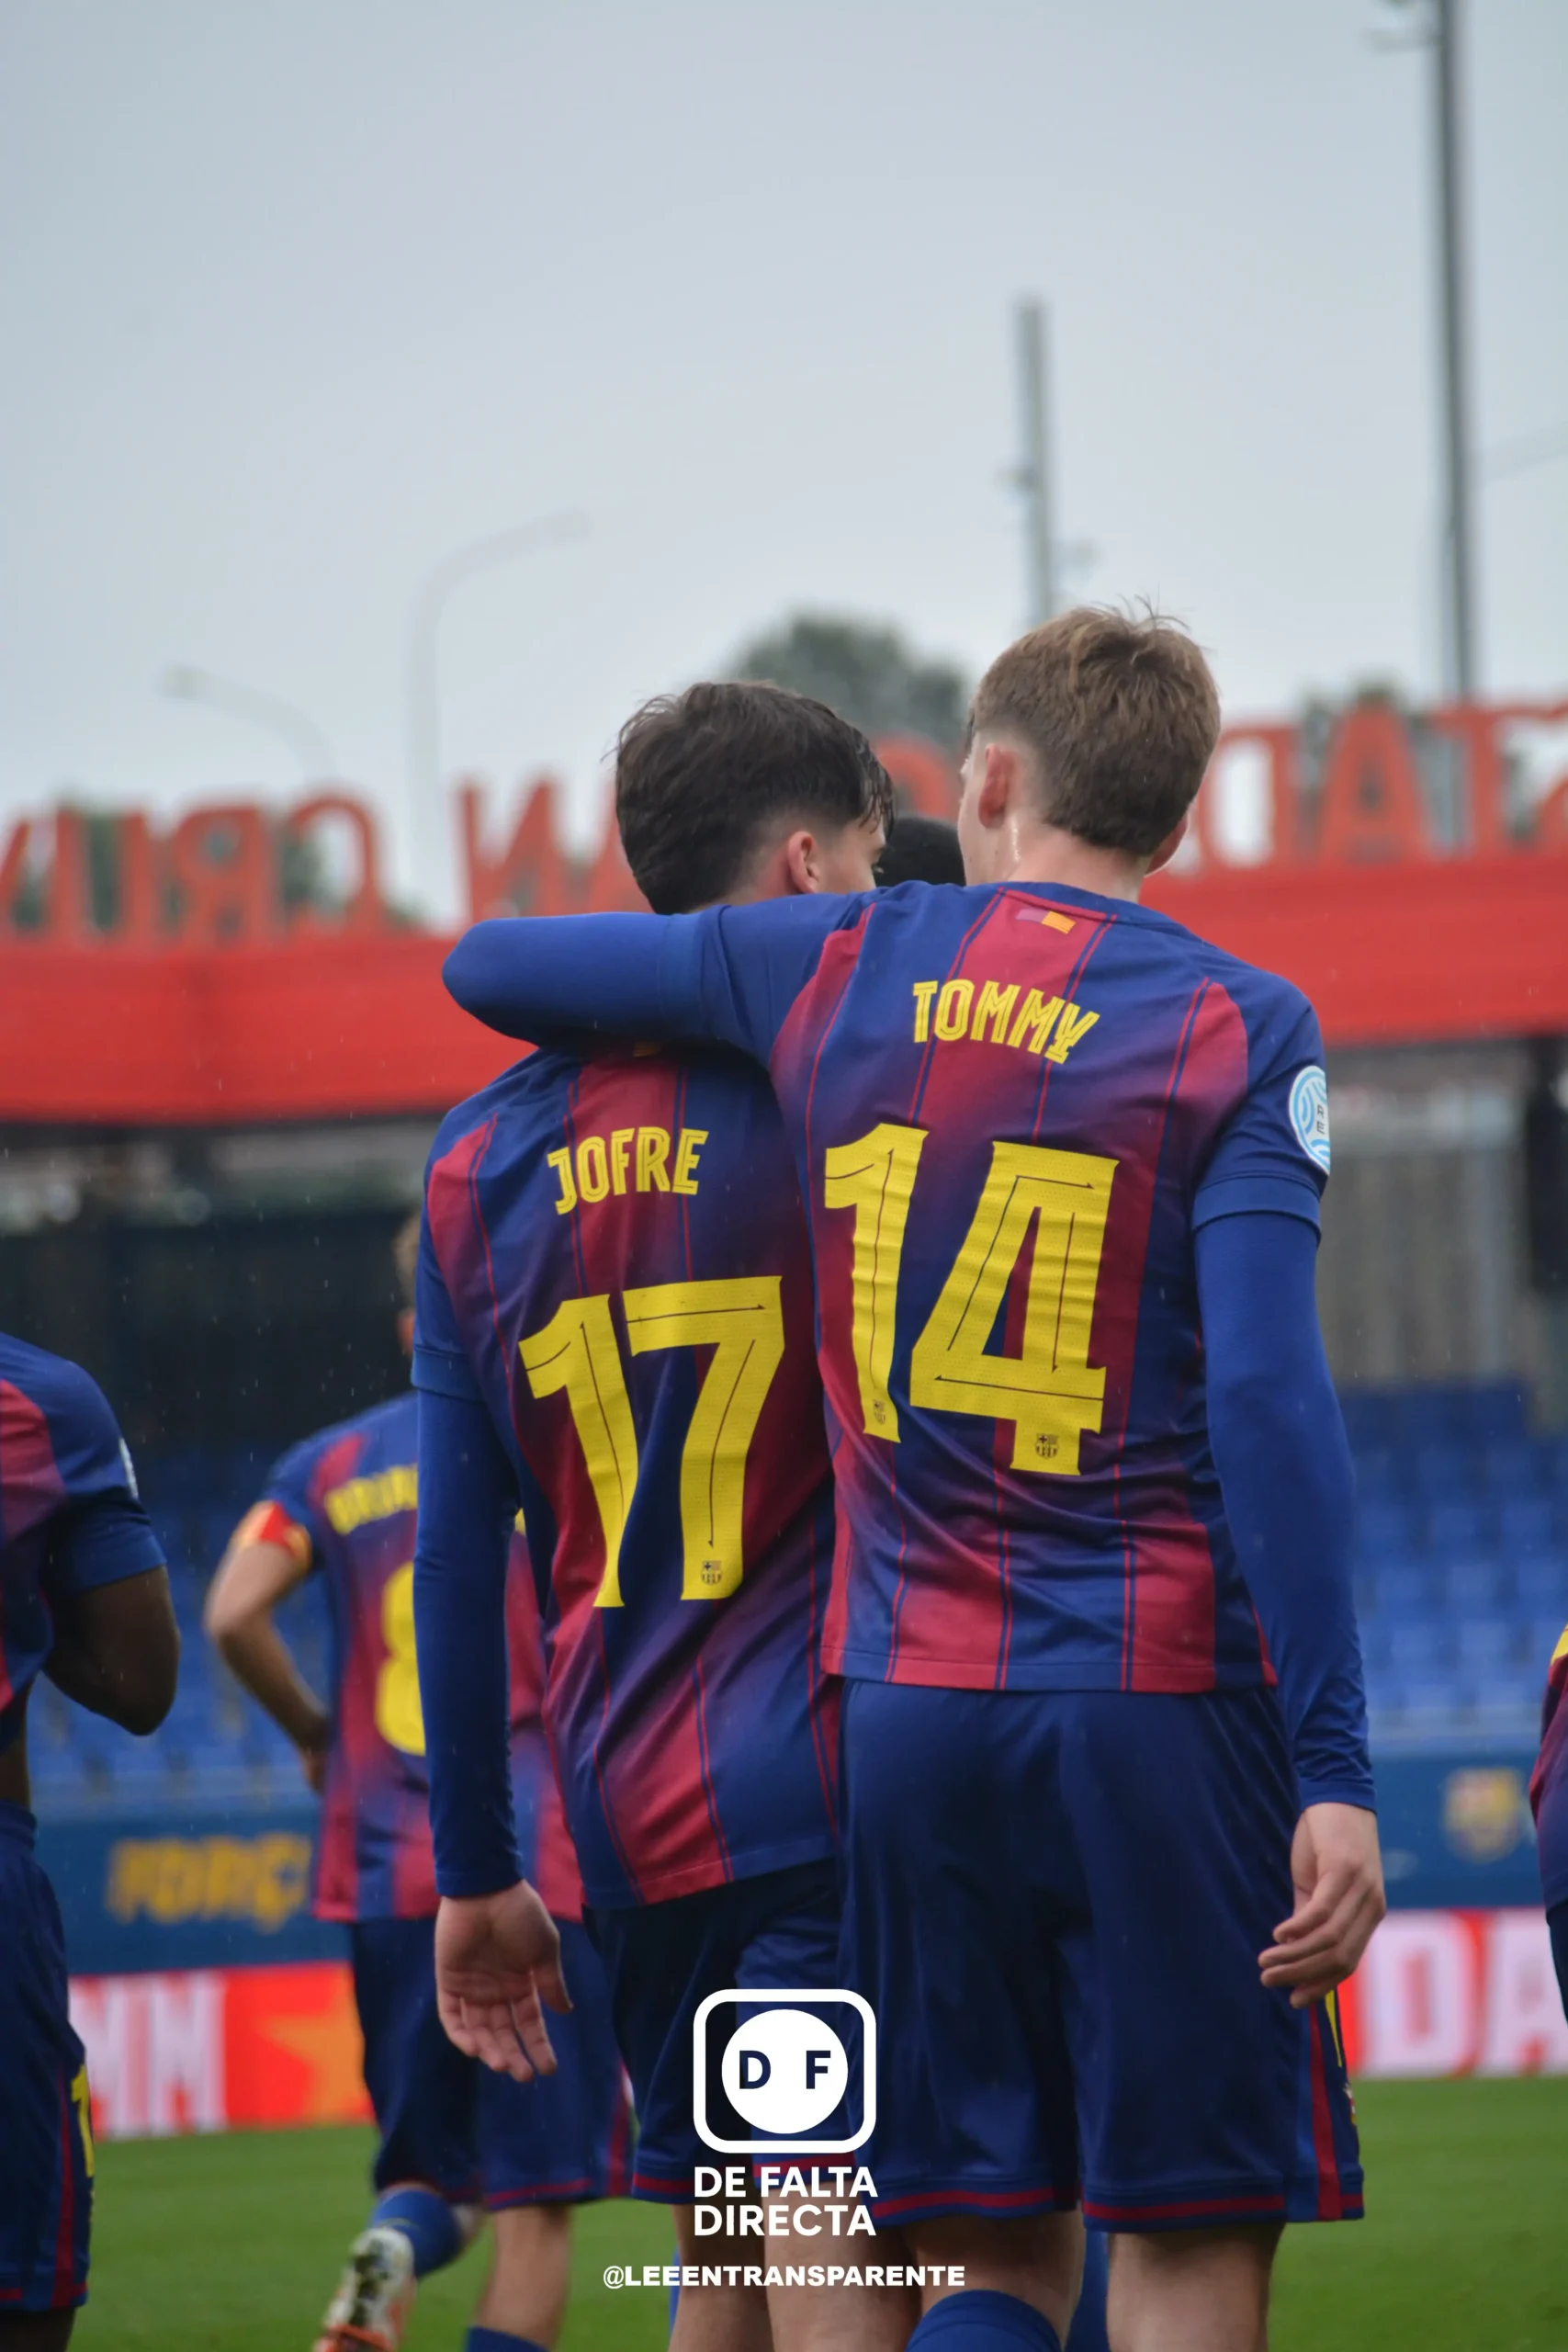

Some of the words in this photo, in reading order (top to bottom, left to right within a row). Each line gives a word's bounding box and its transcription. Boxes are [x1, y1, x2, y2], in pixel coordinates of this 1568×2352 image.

[913, 978, 1100, 1064] TOMMY
[547, 1126, 709, 1215] JOFRE
[825, 1123, 1118, 1476] 14
[515, 1276, 784, 1607] 17
